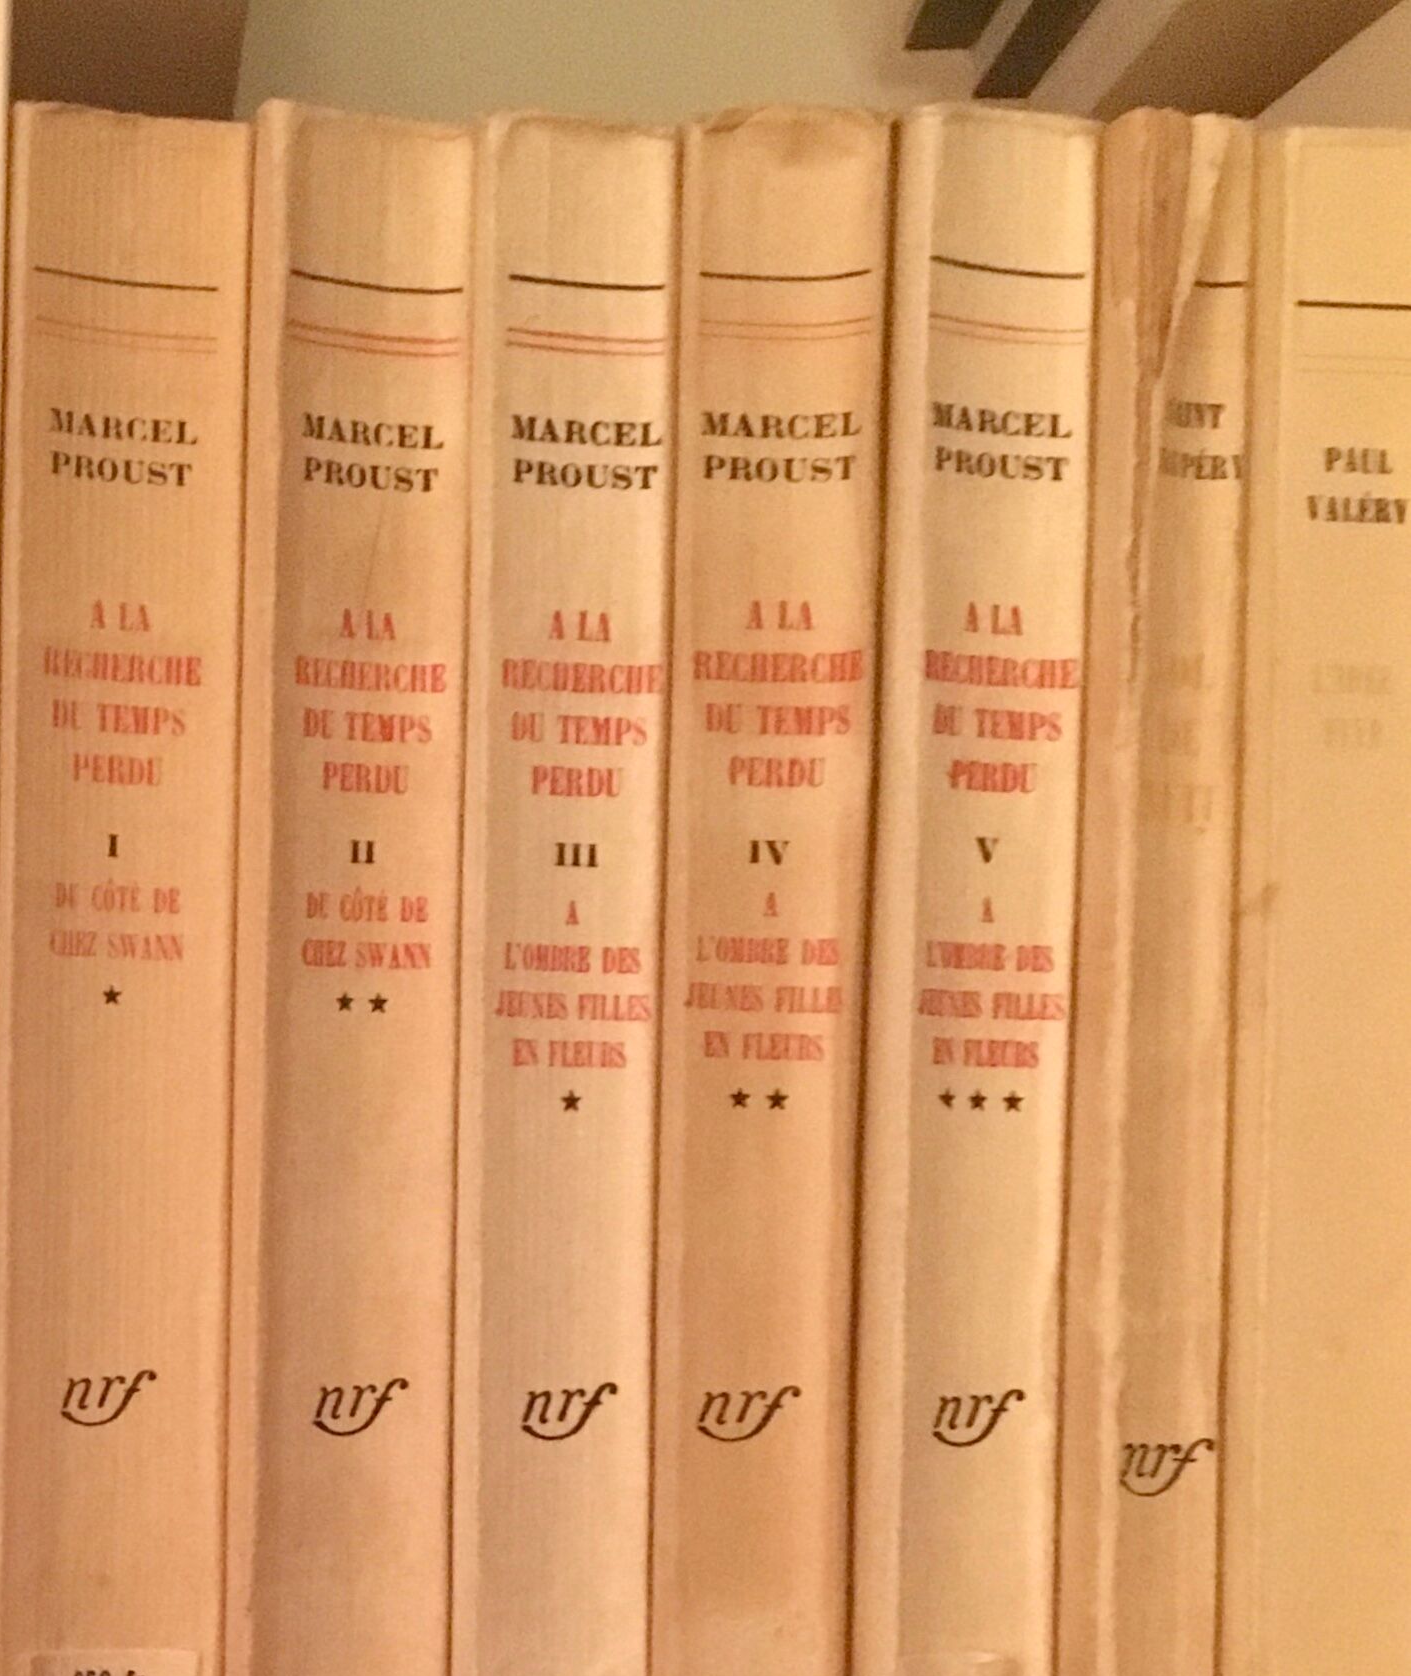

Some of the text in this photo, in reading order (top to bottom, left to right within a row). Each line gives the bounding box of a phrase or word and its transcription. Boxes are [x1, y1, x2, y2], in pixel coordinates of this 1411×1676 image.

[49, 407, 198, 446] MARCEL
[302, 413, 445, 451] MARCEL
[511, 413, 663, 448] MARCEL
[700, 410, 862, 441] MARCEL
[931, 402, 1073, 439] MARCEL
[50, 450, 193, 487] PROUST
[303, 456, 440, 494] PROUST
[512, 456, 659, 490] PROUST
[702, 454, 857, 483] PROUST
[934, 445, 1069, 482] PROUST
[1324, 447, 1394, 474] PAUL
[1307, 491, 1408, 524] VALÉRY
[90, 600, 151, 632] A LA
[340, 608, 396, 641] A LA
[548, 609, 612, 642] A LA
[745, 600, 814, 631] A LA
[964, 601, 1023, 636] A LA
[43, 646, 202, 686] RECHERCHE
[295, 655, 447, 693] RECHERCHE
[501, 658, 664, 695] RECHERCHE
[693, 648, 864, 684] RECHERCHE
[925, 649, 1078, 690] RECHERCHE
[52, 699, 186, 736] DU TEMPS
[303, 707, 433, 743] DU TEMPS
[511, 711, 648, 747] DU TEMPS
[705, 702, 851, 737] DU TEMPS
[932, 703, 1063, 742] DU TEMPS
[72, 753, 162, 786] PERDU
[322, 761, 409, 795] PERDU
[531, 765, 624, 798] PERDU
[727, 756, 825, 788] PERDU
[948, 760, 1037, 794] PERDU
[107, 834, 119, 857] I
[350, 839, 376, 864] II
[554, 842, 599, 868] III
[748, 839, 790, 866] IV
[975, 836, 999, 864] V
[55, 878, 181, 914] DU CÔTÉ DE
[306, 886, 429, 922] DU CÔTÉ DE
[565, 900, 579, 926] A
[49, 930, 184, 962] CHEZ SWANN
[301, 939, 432, 969] CHEZ SWANN
[504, 942, 641, 974] L'OMBRE DES
[696, 935, 840, 967] L'OMBRE DES
[1016, 945, 1055, 973] DES
[495, 989, 652, 1022] JEUNES FILLES
[684, 981, 764, 1012] JEUNES
[991, 992, 1065, 1020] FILLES
[512, 1038, 627, 1069] EN FLEURS
[703, 1030, 826, 1062] EN FLEURS
[963, 1038, 1039, 1068] FLEURS
[60, 1368, 157, 1426] nrf
[312, 1377, 409, 1436] nrf
[521, 1381, 619, 1441] nrf
[697, 1385, 801, 1442] nrf
[933, 1388, 1026, 1447] nrf
[1119, 1437, 1215, 1497] nrf
